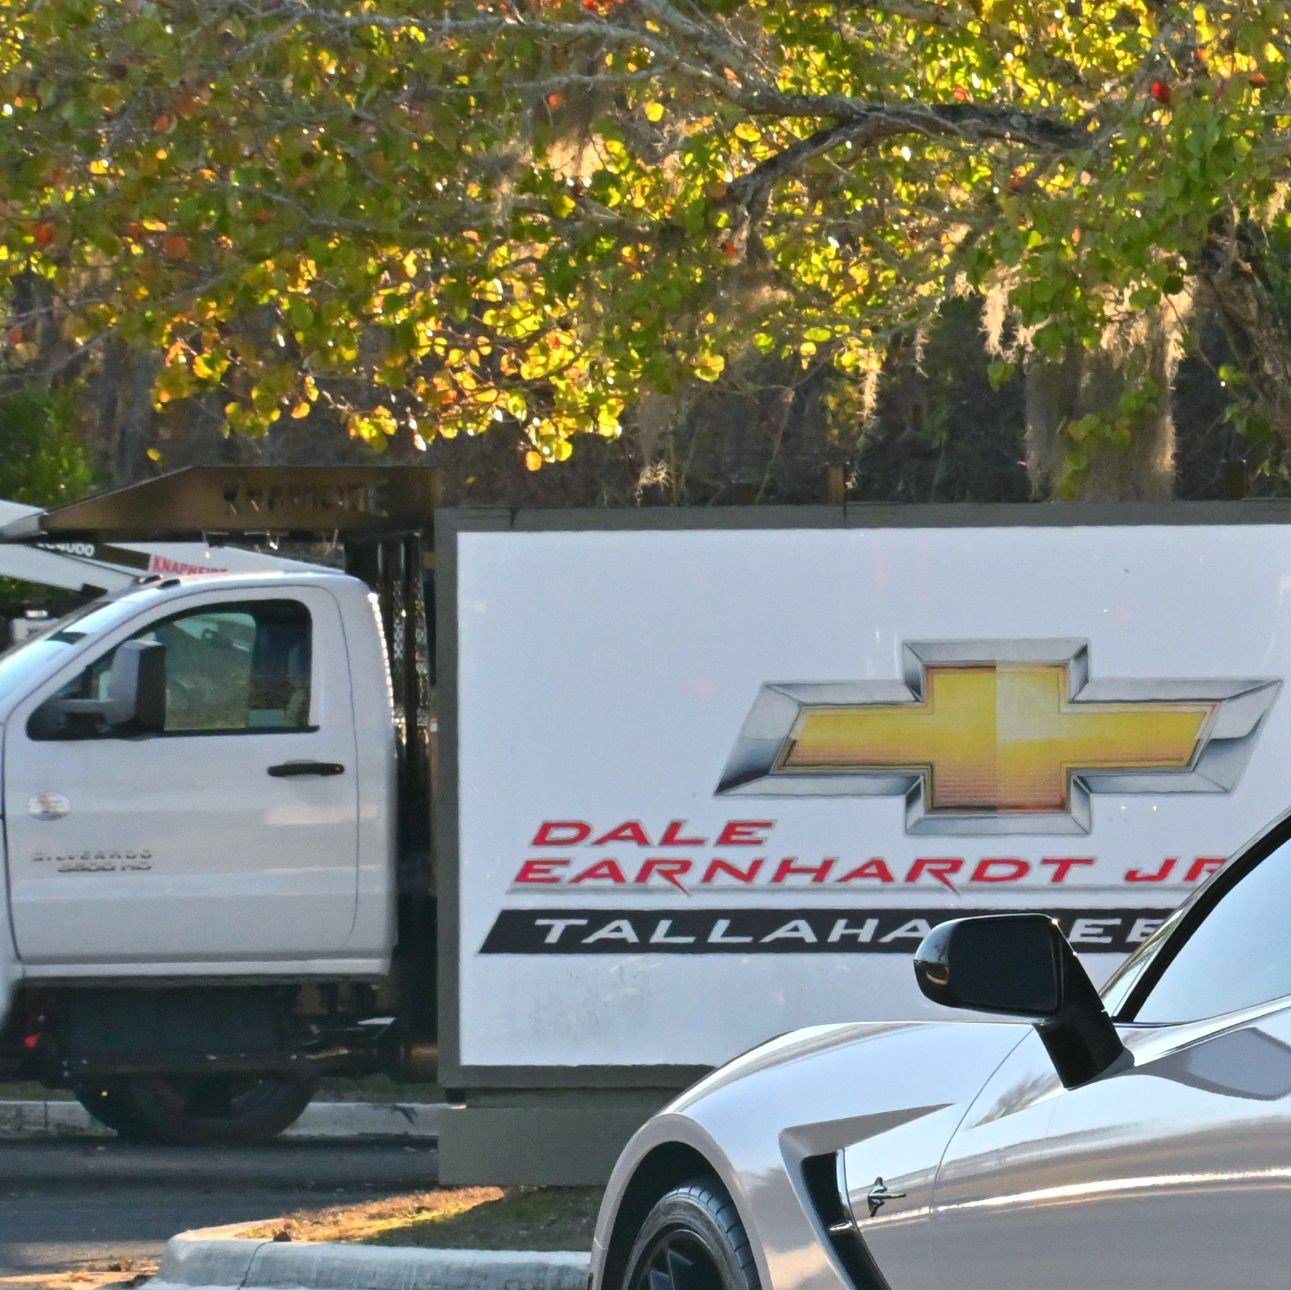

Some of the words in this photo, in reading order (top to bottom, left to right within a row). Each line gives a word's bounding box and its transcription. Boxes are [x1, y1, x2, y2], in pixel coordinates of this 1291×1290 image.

[532, 820, 774, 847] DALE
[514, 858, 1094, 894] EARNHARDT
[534, 917, 1167, 944] TALLAHAEE
